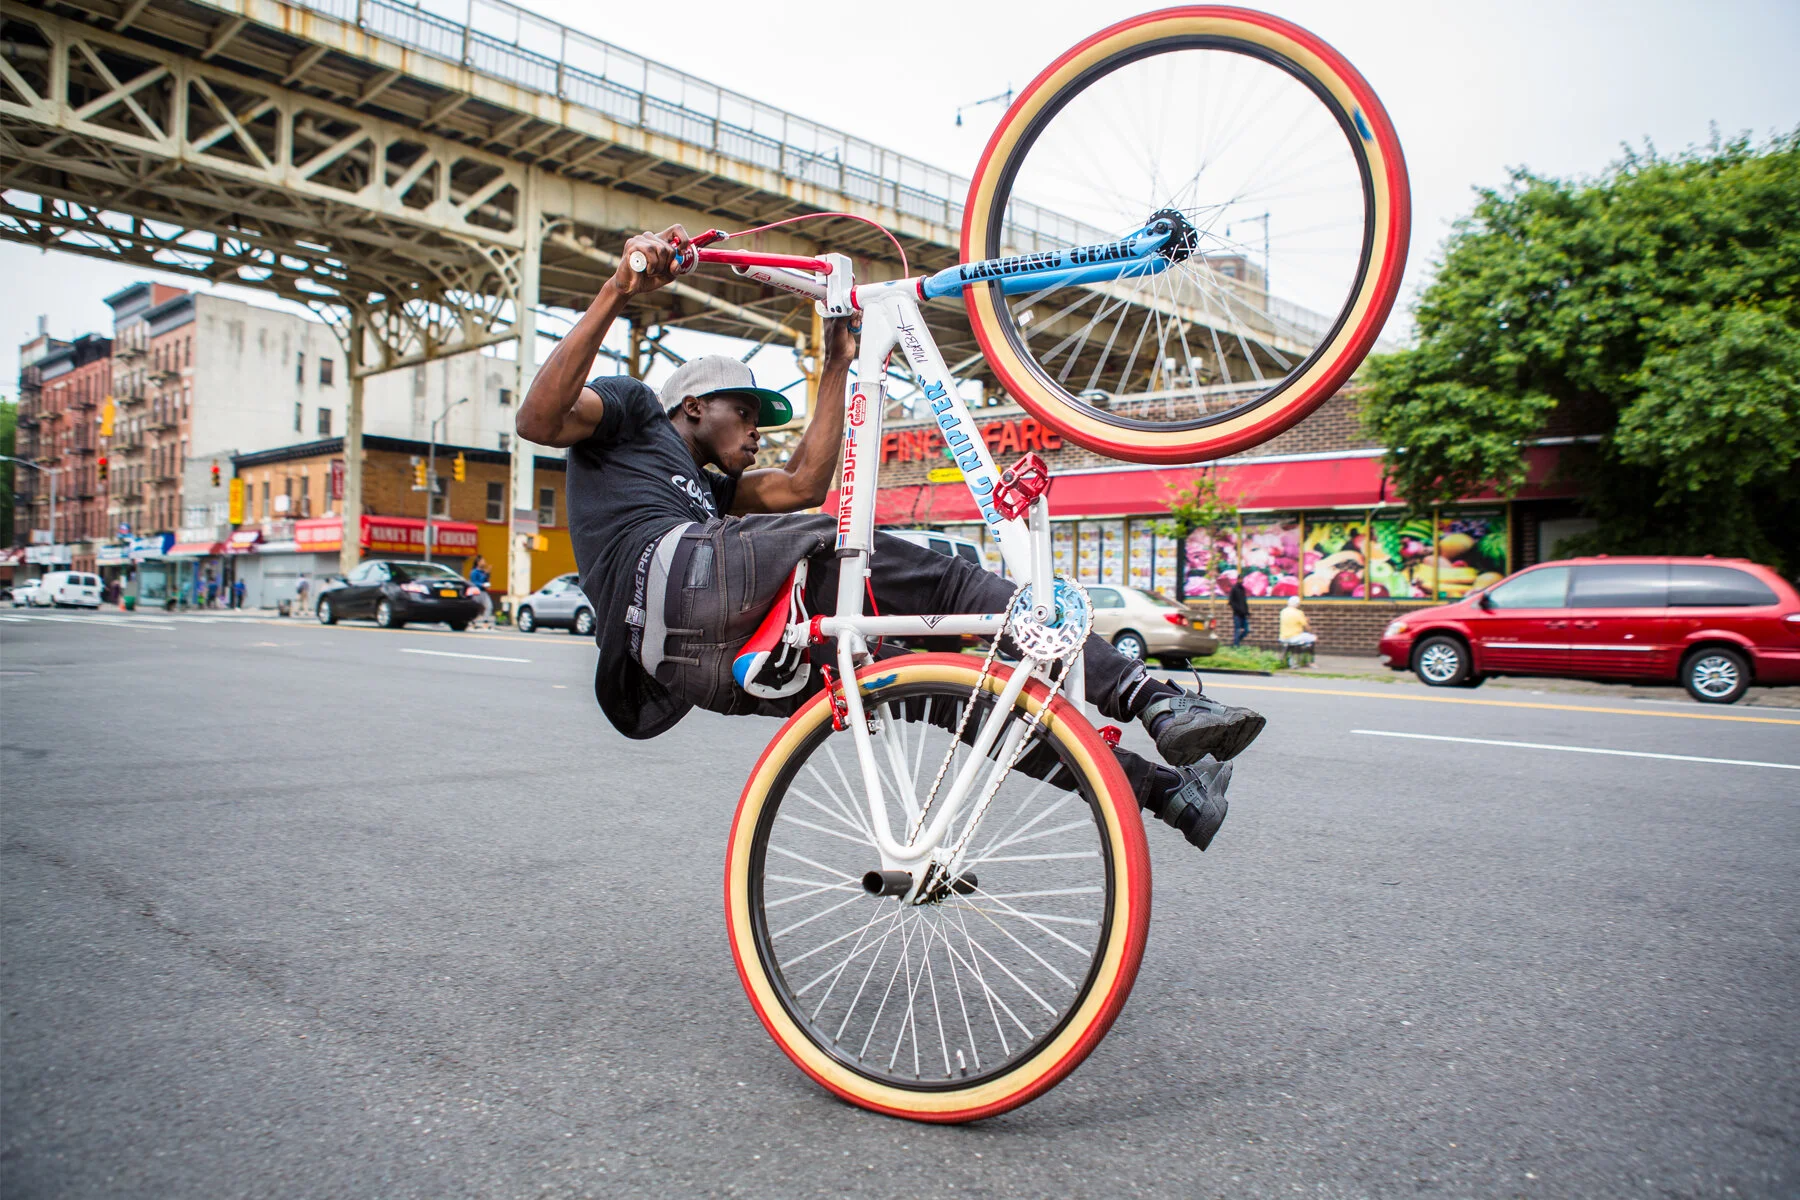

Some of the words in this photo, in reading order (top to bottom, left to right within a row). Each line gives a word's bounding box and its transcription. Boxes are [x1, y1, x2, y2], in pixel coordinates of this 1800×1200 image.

[959, 250, 1062, 281] LANDING
[1070, 240, 1138, 265] GEAR
[843, 438, 857, 484] BUFF
[881, 429, 940, 464] FINE
[982, 418, 1063, 454] FARE
[632, 573, 645, 609] NIKE
